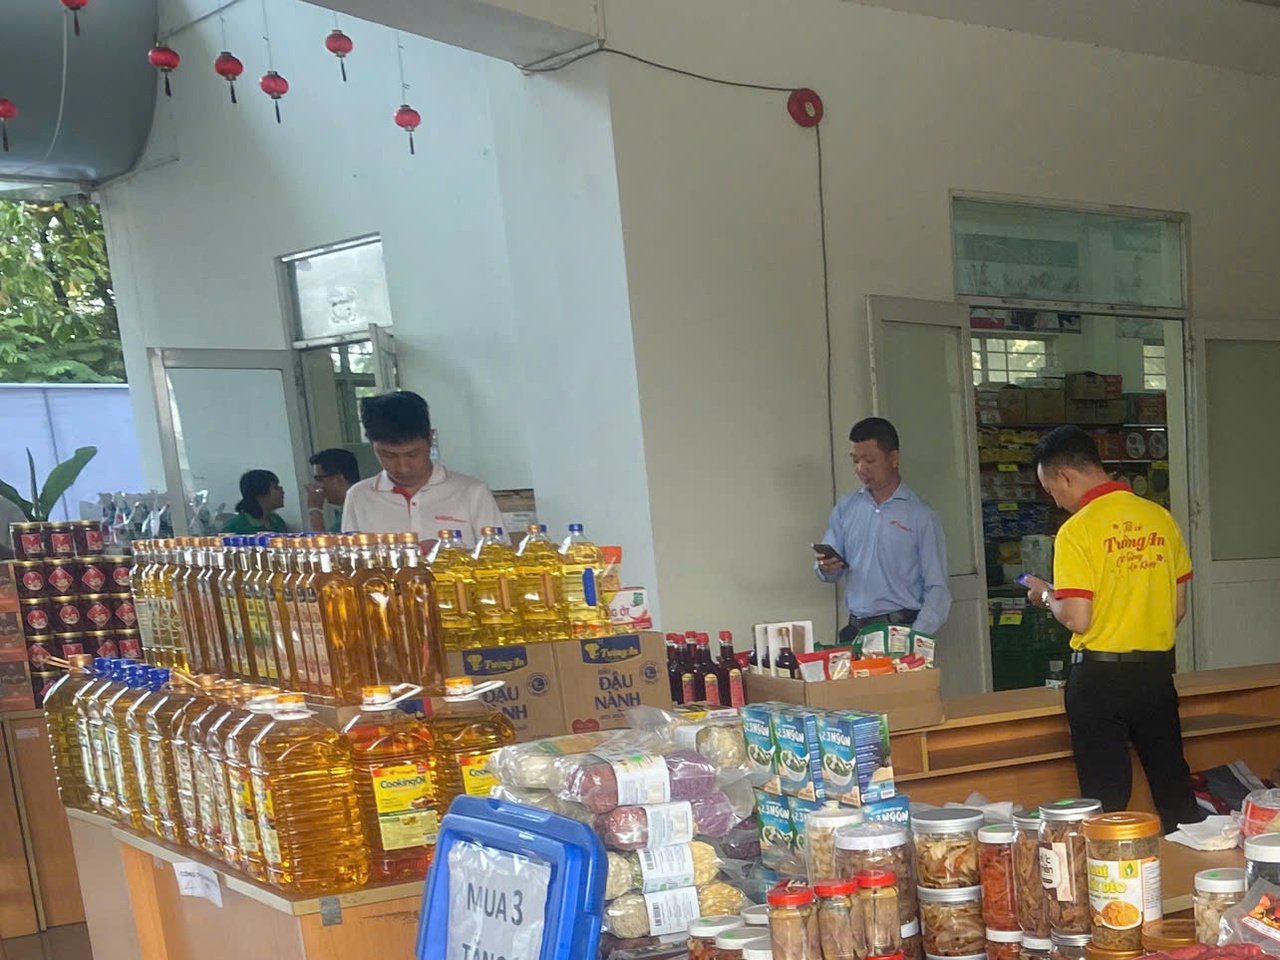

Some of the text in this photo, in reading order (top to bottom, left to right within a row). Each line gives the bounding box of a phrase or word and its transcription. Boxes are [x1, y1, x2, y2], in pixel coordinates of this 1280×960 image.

[598, 669, 634, 691] ĐẬU
[594, 690, 642, 711] NÀNH
[467, 882, 524, 926] MUA 3
